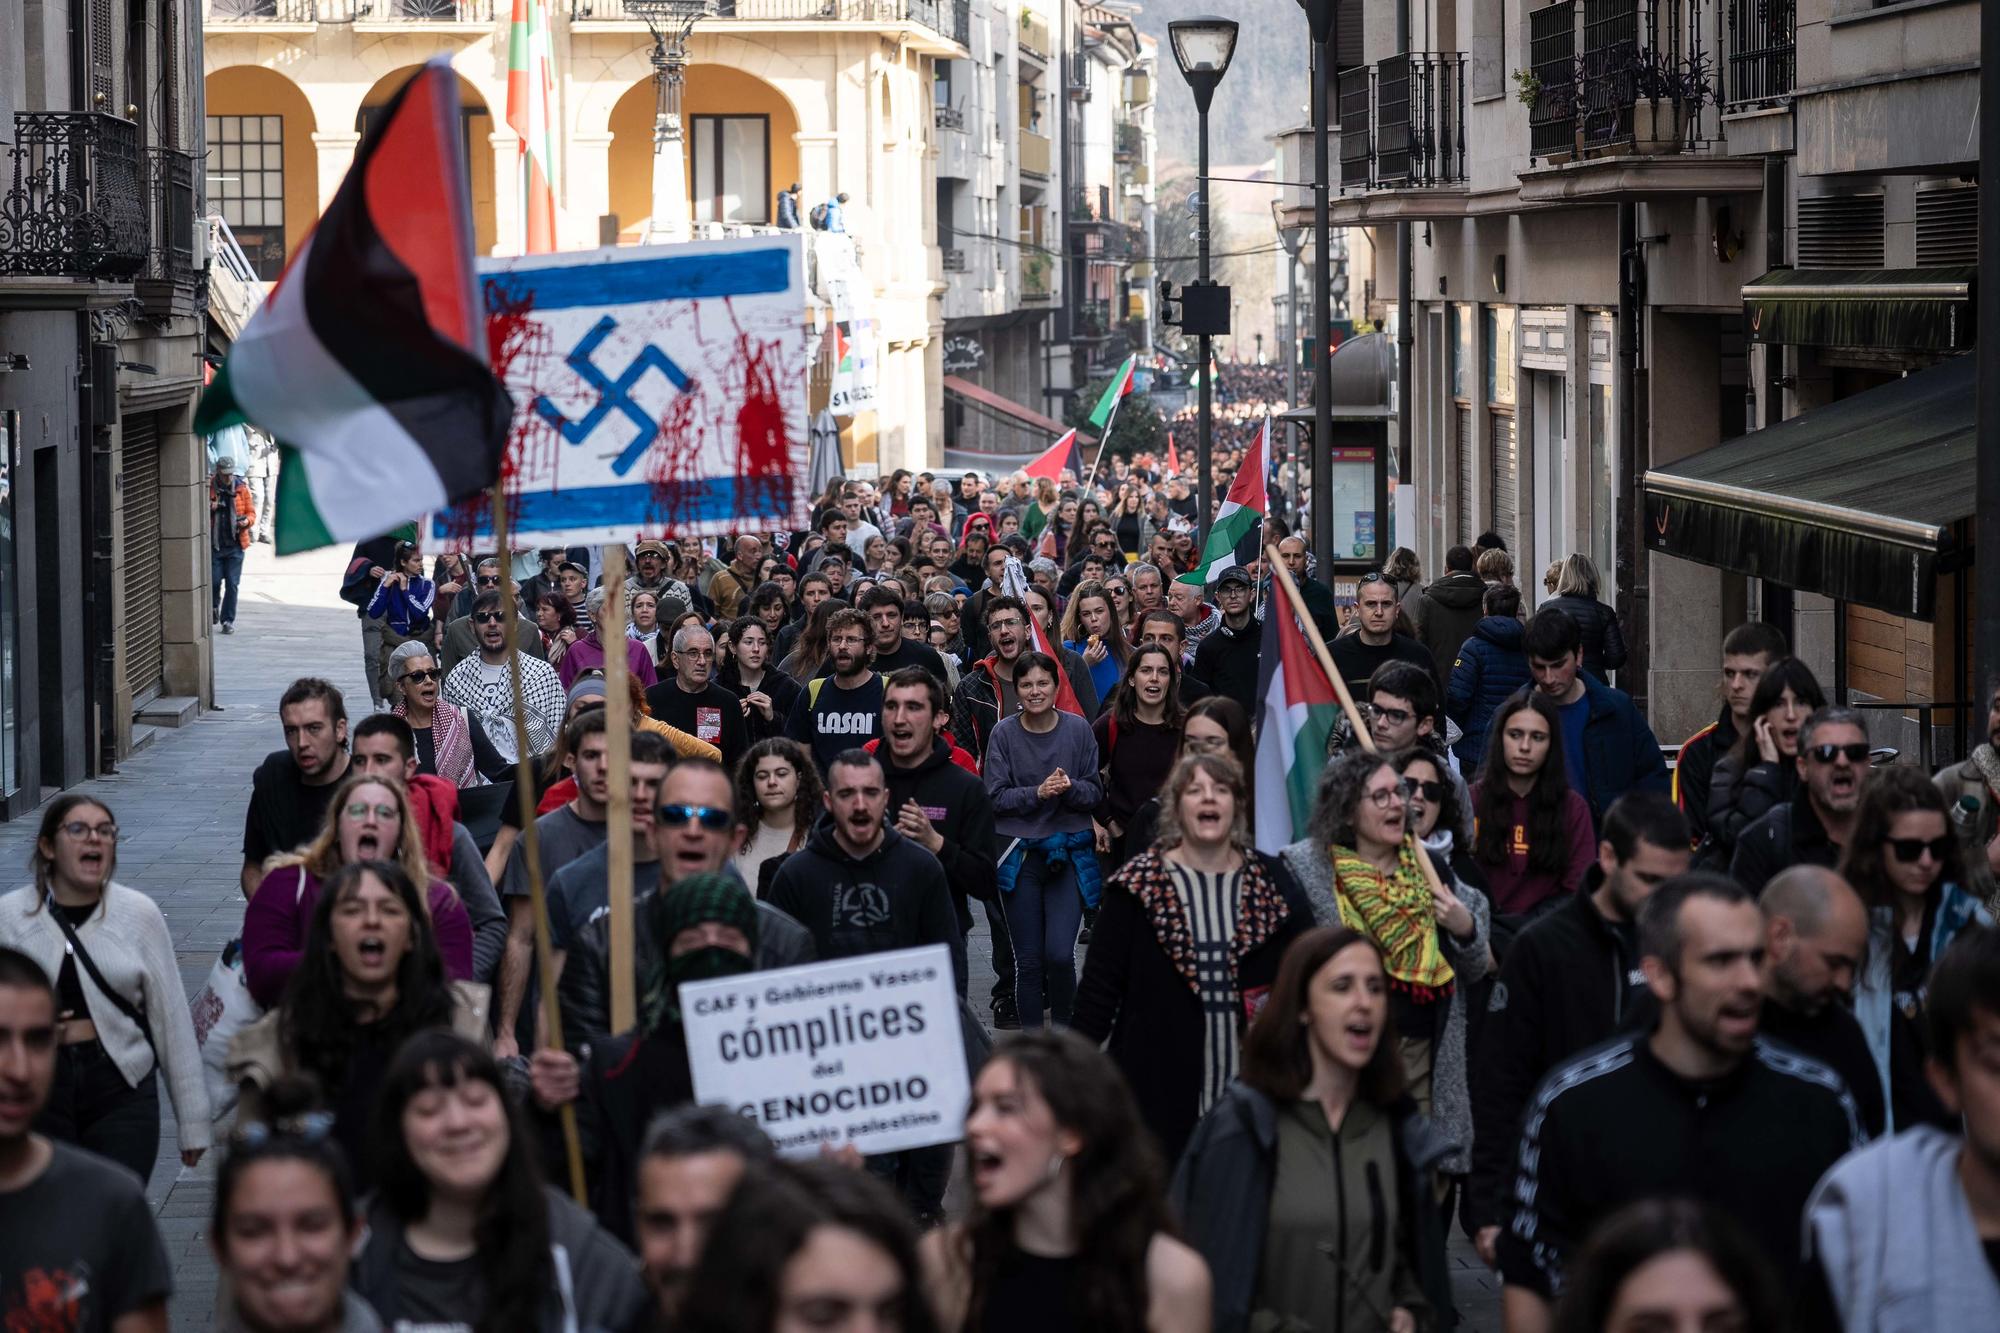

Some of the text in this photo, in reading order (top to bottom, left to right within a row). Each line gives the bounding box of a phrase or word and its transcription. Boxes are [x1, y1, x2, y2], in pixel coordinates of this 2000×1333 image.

[817, 712, 873, 735] LASAI
[694, 966, 938, 1015] CAF y Gobierno Vasco
[718, 1002, 926, 1064] cómplices
[812, 1060, 844, 1079] del
[845, 1111, 941, 1138] palestino
